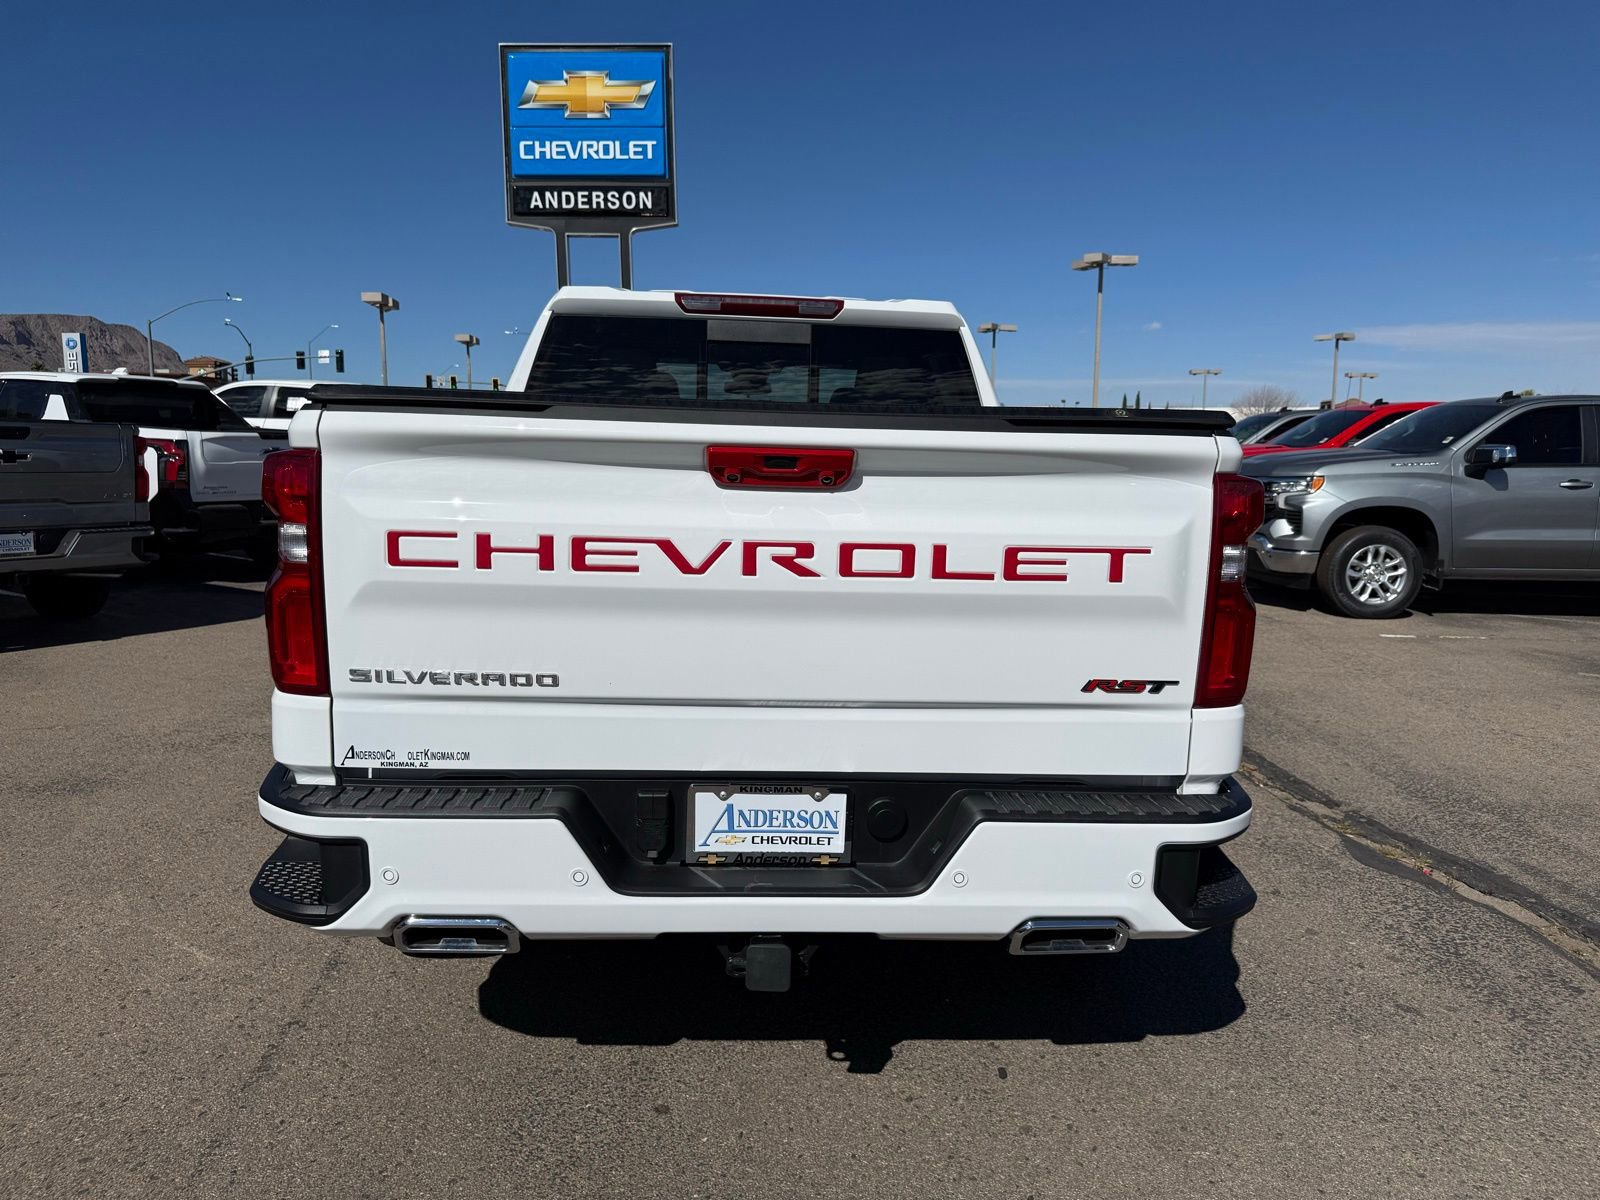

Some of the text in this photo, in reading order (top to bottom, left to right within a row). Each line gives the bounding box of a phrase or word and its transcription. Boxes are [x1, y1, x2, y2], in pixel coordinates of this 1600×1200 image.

[519, 140, 657, 160] CHEVROLET
[530, 191, 653, 210] ANDERSON
[67, 351, 78, 373] SE
[386, 530, 1152, 584] CHEVROLET
[348, 668, 560, 688] SILVERADO
[1081, 679, 1180, 695] RST
[739, 785, 803, 794] KINGMAN
[699, 803, 840, 847] ANDERSON
[751, 835, 834, 846] CHEVROLET
[732, 853, 808, 866] Anderson
